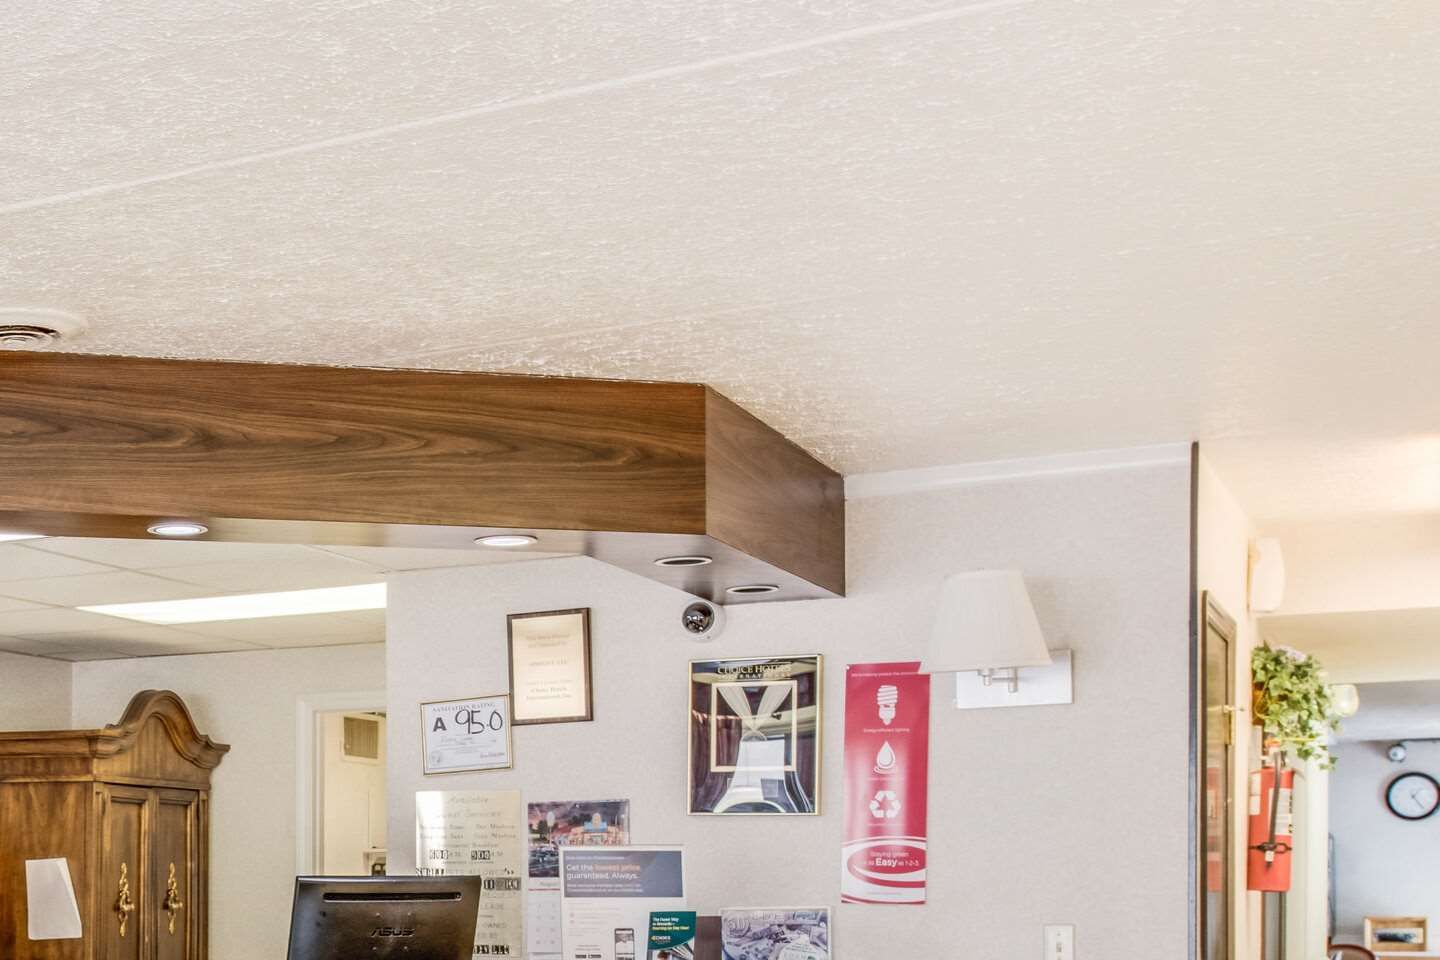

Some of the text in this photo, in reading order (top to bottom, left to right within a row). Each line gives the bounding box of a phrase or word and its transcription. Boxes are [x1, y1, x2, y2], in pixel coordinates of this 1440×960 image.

[433, 717, 447, 732] A
[875, 857, 898, 868] Easy
[371, 927, 416, 937] ASUS
